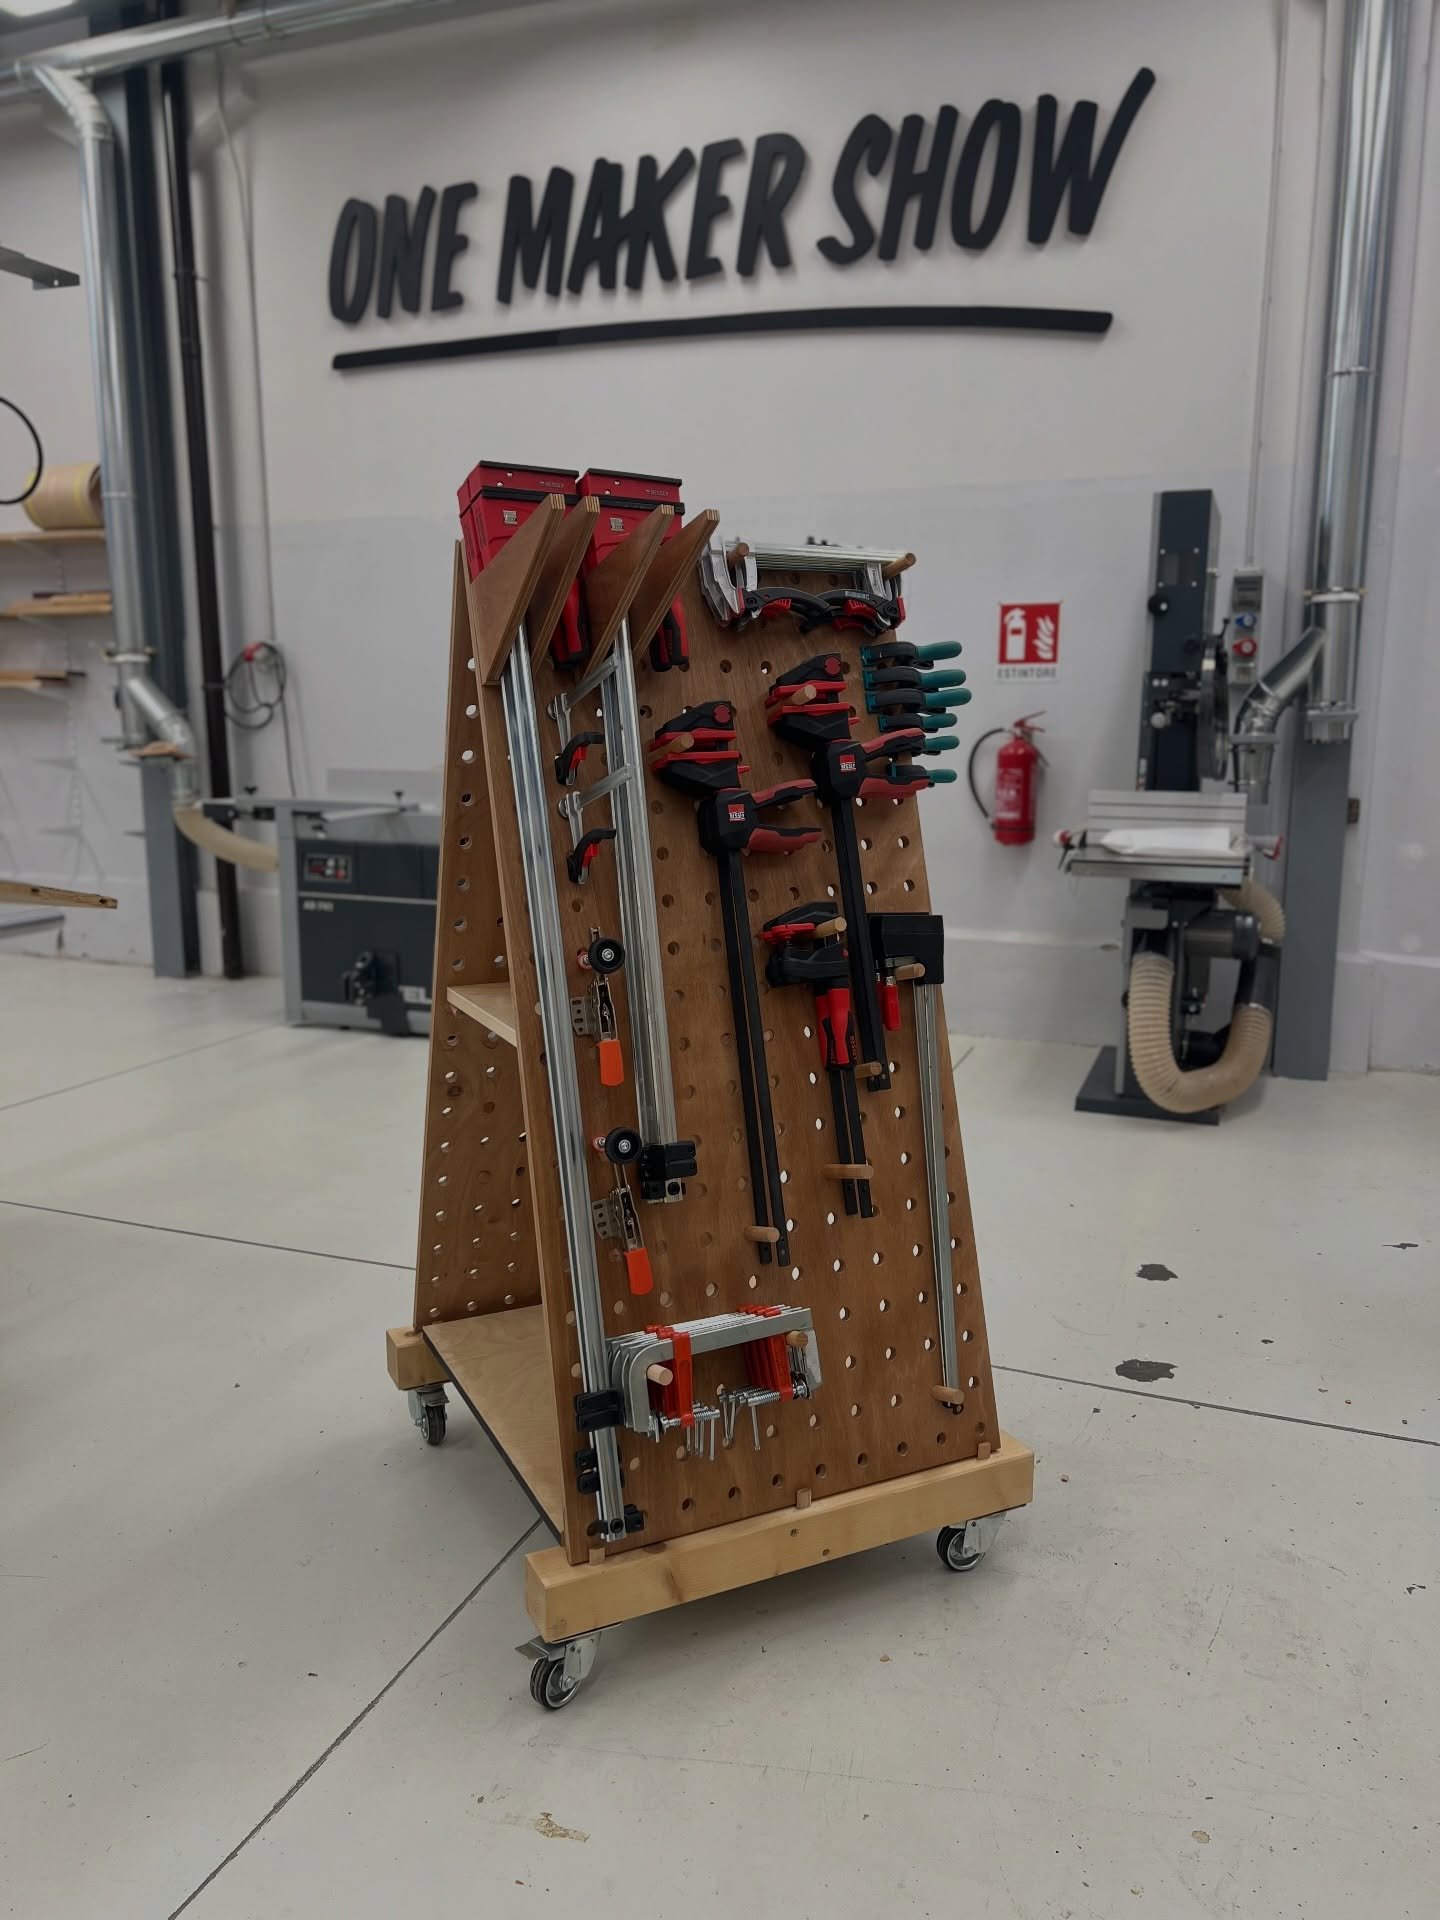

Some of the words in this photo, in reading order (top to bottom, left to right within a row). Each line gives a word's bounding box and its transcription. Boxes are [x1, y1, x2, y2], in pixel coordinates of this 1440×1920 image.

[329, 182, 479, 325] ONE
[497, 133, 807, 305] MAKER
[816, 67, 1156, 267] SHOW
[997, 667, 1057, 679] ESTINTORE
